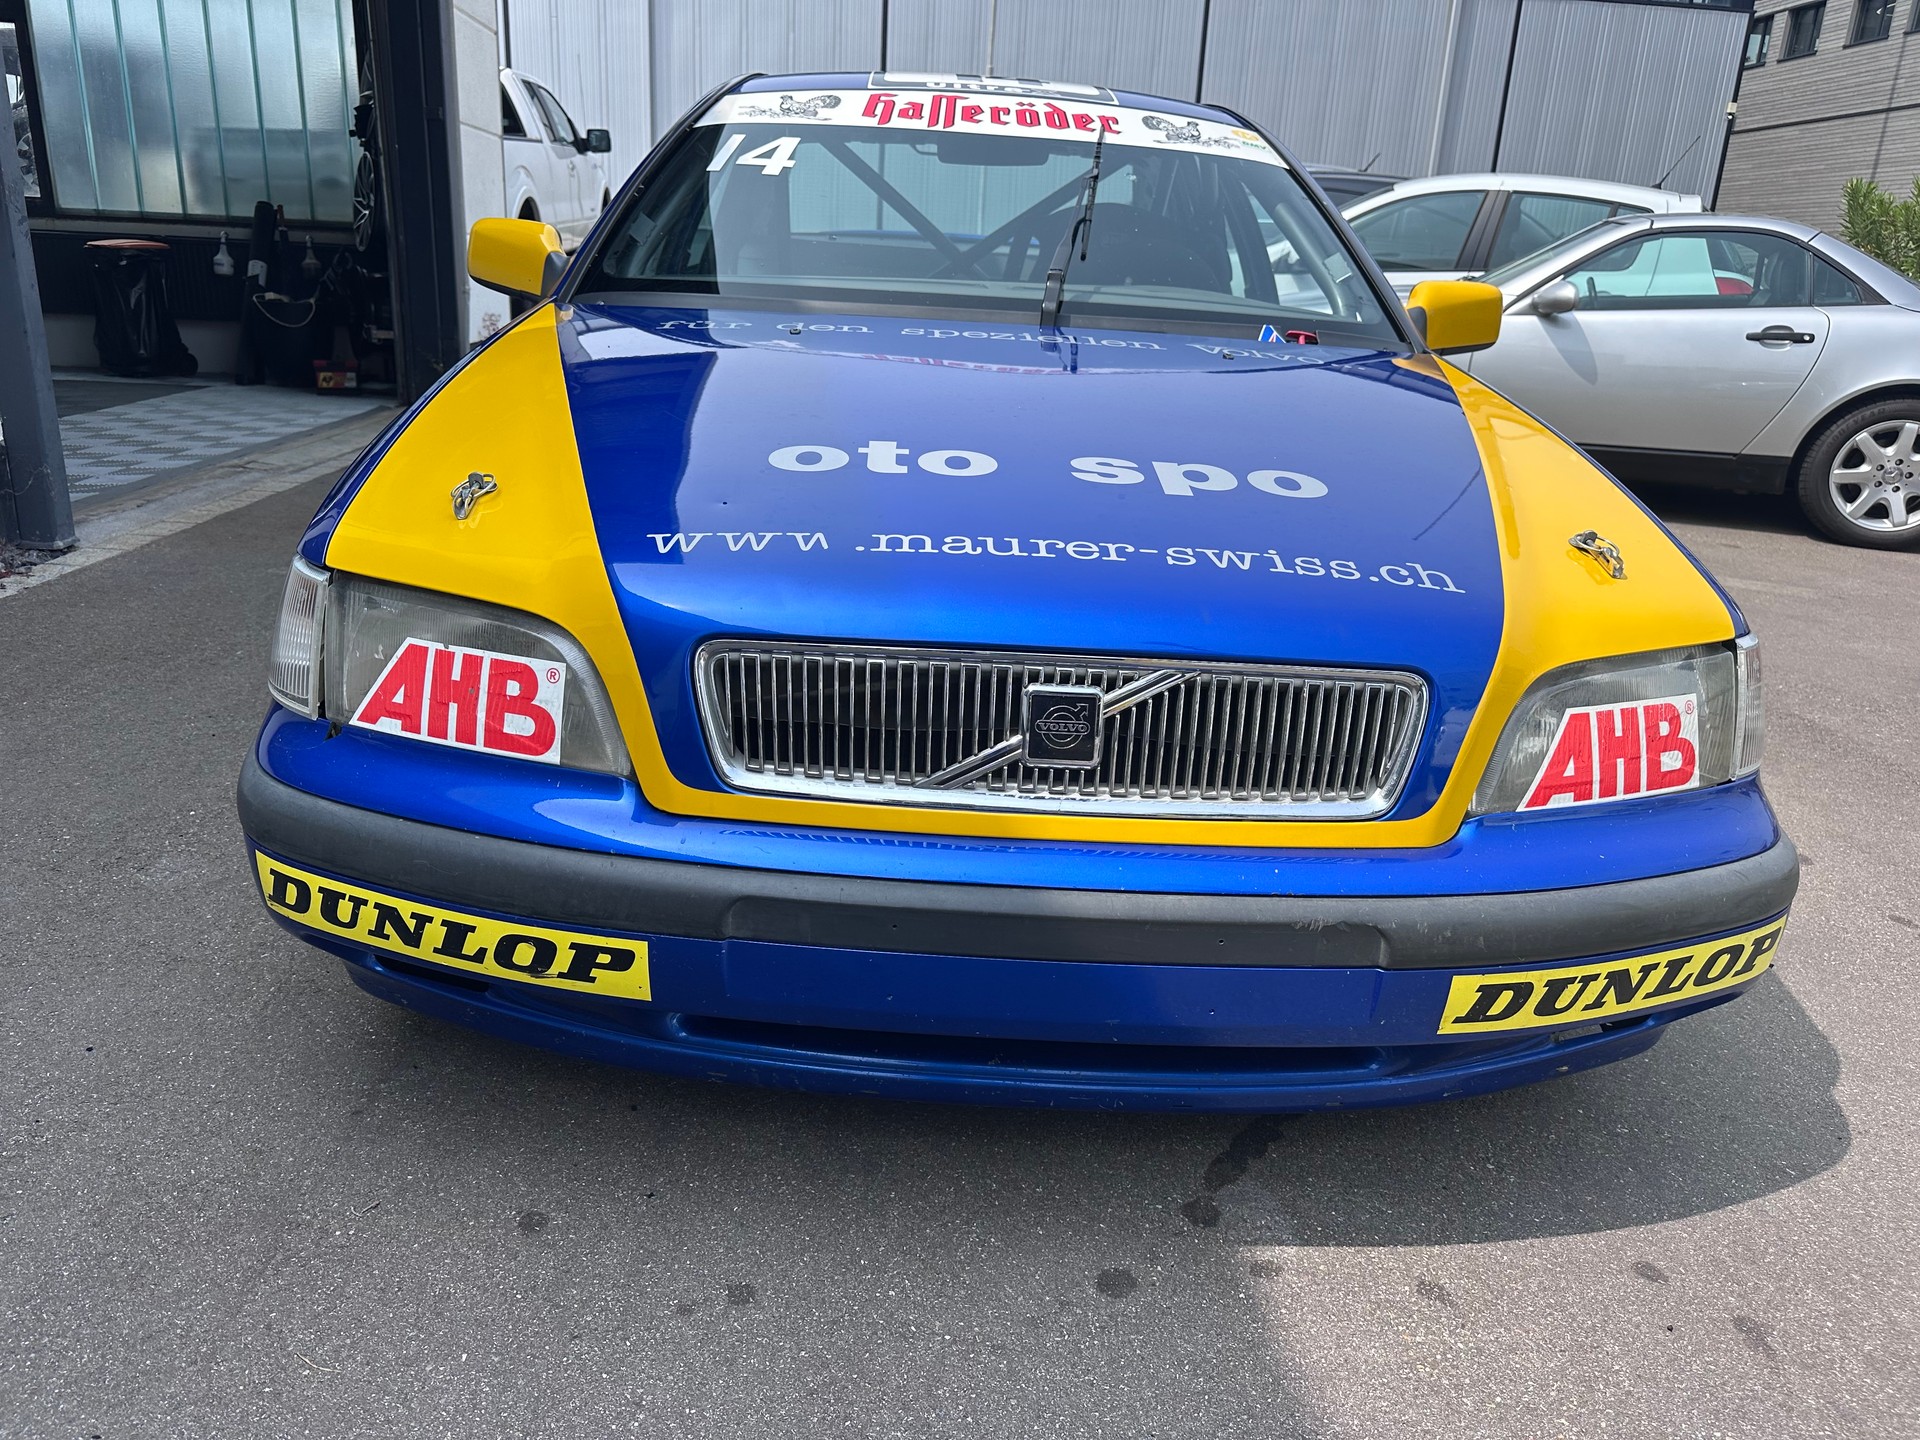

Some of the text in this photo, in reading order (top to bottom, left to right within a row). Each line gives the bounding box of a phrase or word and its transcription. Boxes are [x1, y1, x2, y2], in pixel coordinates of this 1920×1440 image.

[706, 133, 801, 176] 14
[655, 320, 752, 330] für
[776, 322, 874, 334] den
[901, 327, 1168, 351] speziellen
[768, 440, 1329, 498] oto spo
[1038, 722, 1088, 732] VOLVO
[267, 868, 636, 984] DUNLOP
[1452, 925, 1783, 1024] DUNLOP
